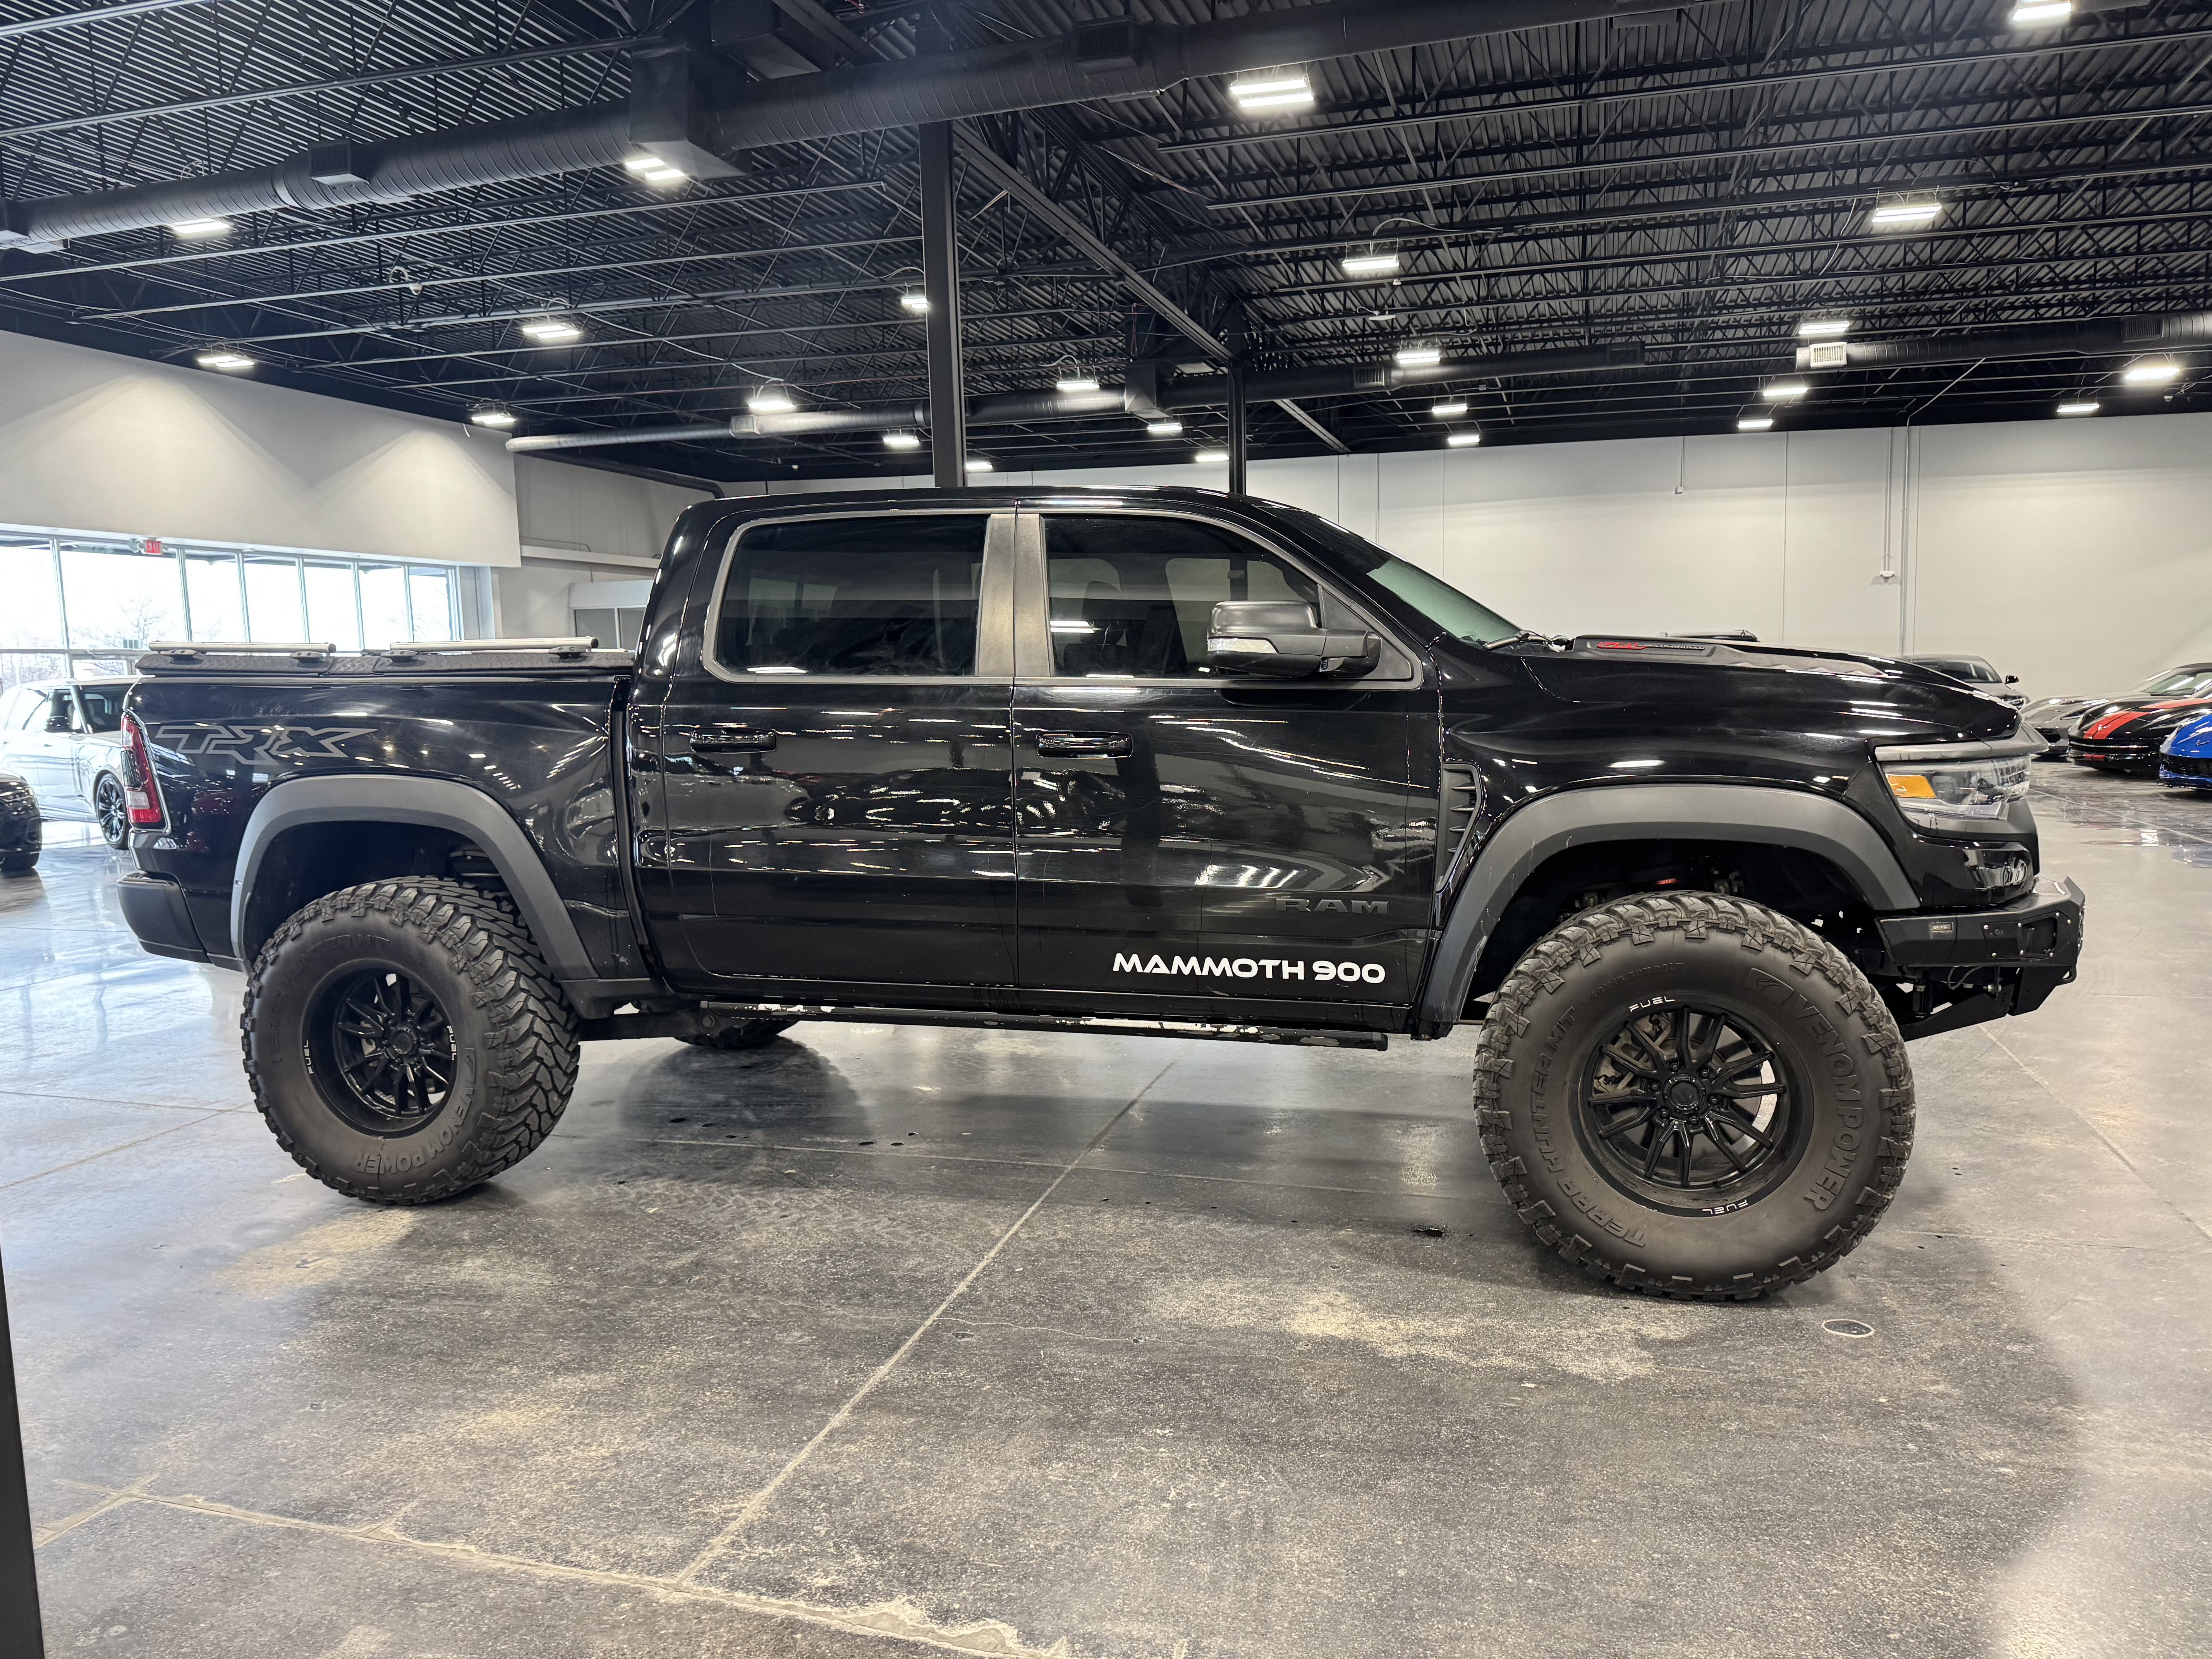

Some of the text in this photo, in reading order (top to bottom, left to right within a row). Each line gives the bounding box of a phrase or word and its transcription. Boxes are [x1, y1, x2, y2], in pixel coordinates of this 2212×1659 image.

[155, 725, 378, 766] TRX
[1275, 898, 1389, 914] RAM
[1112, 953, 1386, 983] MAMMOTH 900
[1628, 996, 1676, 1012] FUEL
[304, 1040, 314, 1074] FUEL
[446, 1025, 457, 1061] FUEL
[1786, 994, 1863, 1211] VENOM POWER
[354, 1087, 474, 1174] VENOM POWER
[1557, 1177, 1646, 1247] TERRA
[1702, 1199, 1748, 1215] FUEL
